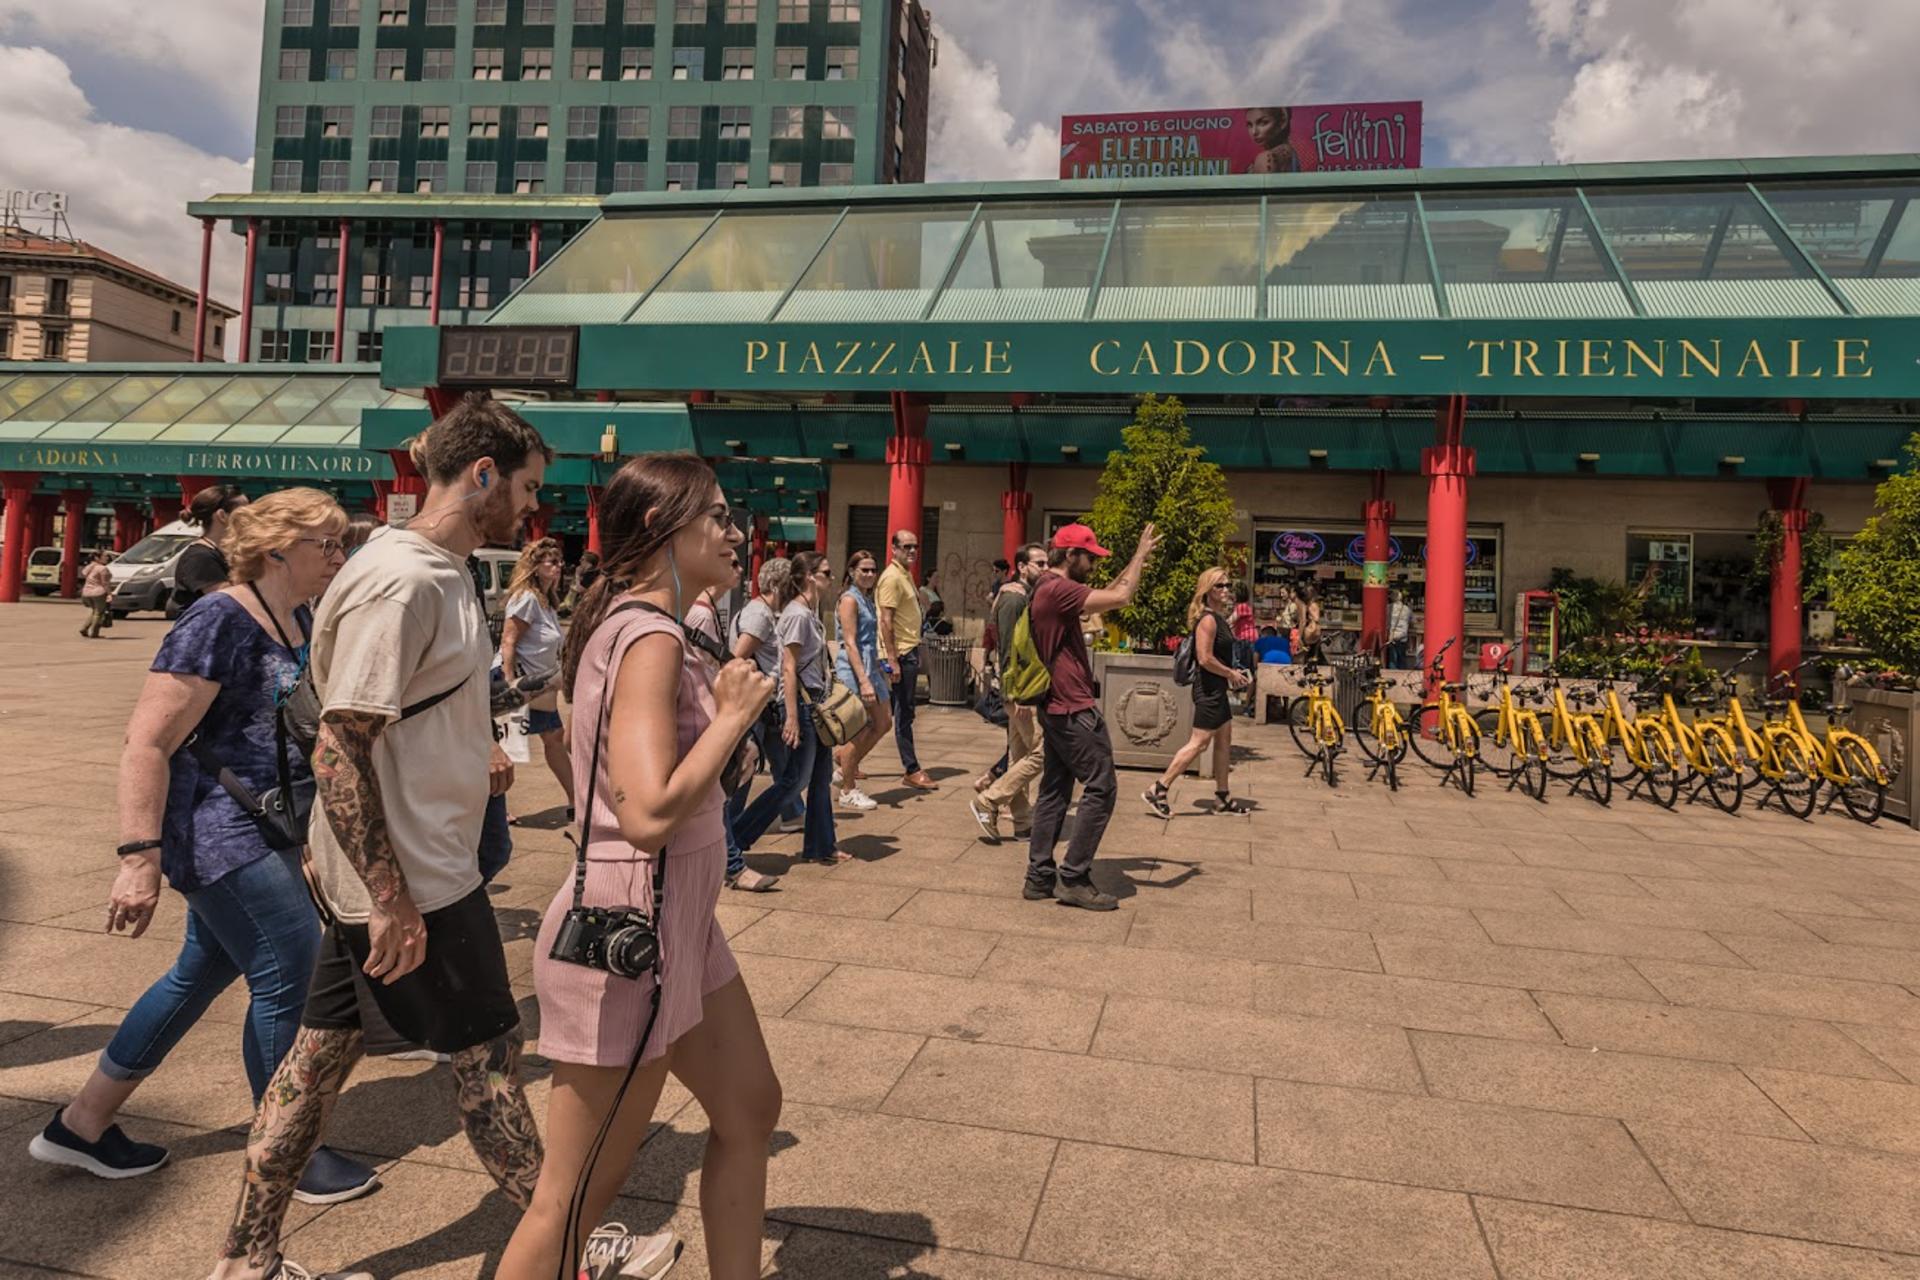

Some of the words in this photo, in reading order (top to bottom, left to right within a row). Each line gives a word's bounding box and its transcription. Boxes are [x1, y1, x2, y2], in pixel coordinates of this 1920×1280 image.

[1072, 121, 1139, 136] SABATO
[1143, 119, 1160, 133] 16
[1164, 116, 1233, 132] GIUGNO
[1102, 134, 1201, 162] ELETTRA
[745, 340, 1013, 375] PIAZZALE
[1089, 339, 1398, 377] CADORNA
[1467, 338, 1874, 378] TRIENNALE
